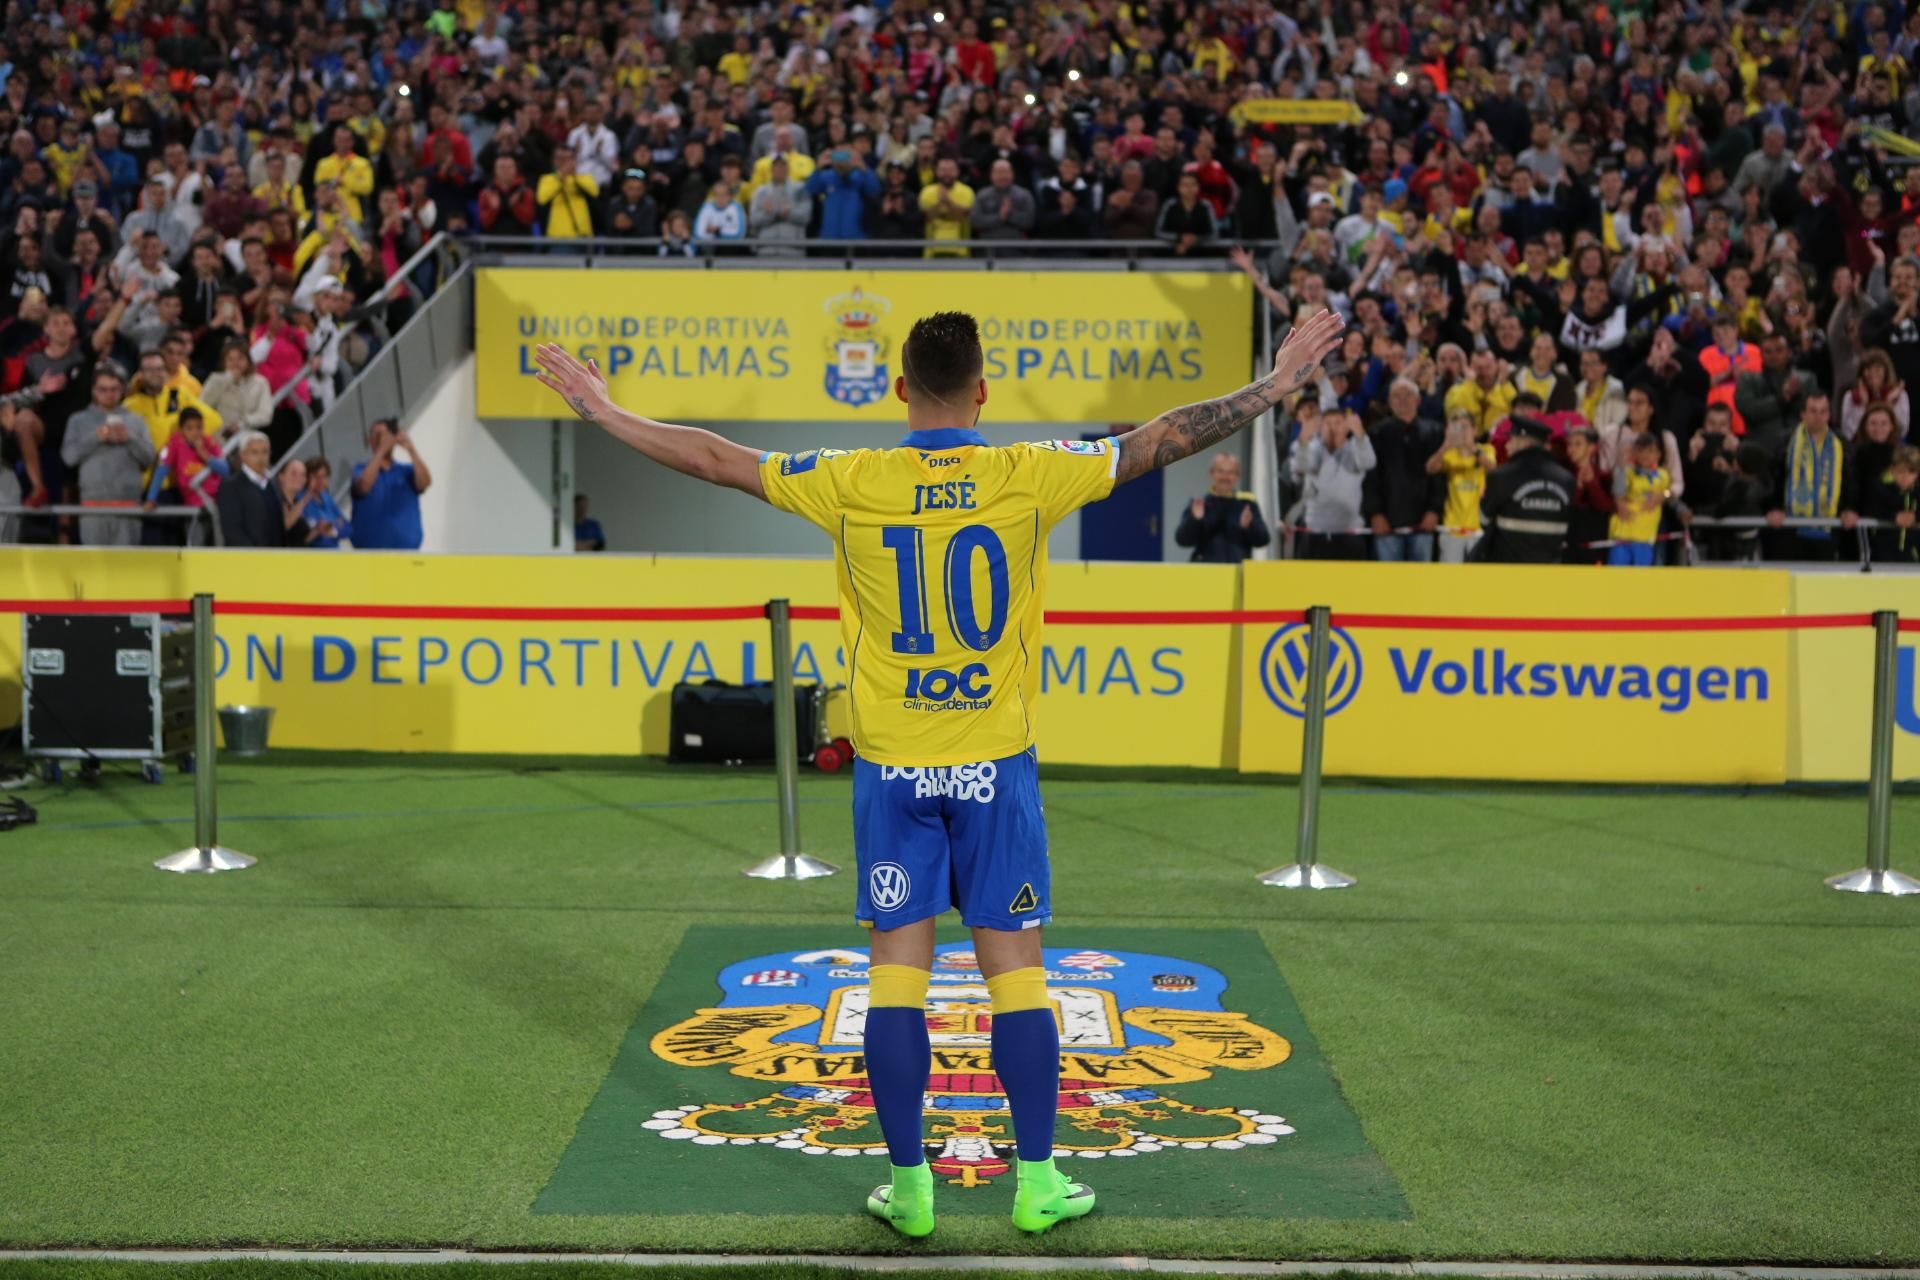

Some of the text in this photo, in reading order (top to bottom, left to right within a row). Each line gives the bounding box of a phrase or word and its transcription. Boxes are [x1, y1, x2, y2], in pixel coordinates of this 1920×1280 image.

[608, 344, 791, 378] PALMAS
[1016, 347, 1204, 381] PALMAS
[911, 474, 977, 515] JESÉ
[882, 524, 1010, 655] 10
[905, 662, 992, 701] IOC
[1042, 646, 1185, 696] MAS
[1388, 647, 1769, 713] Volkswagen
